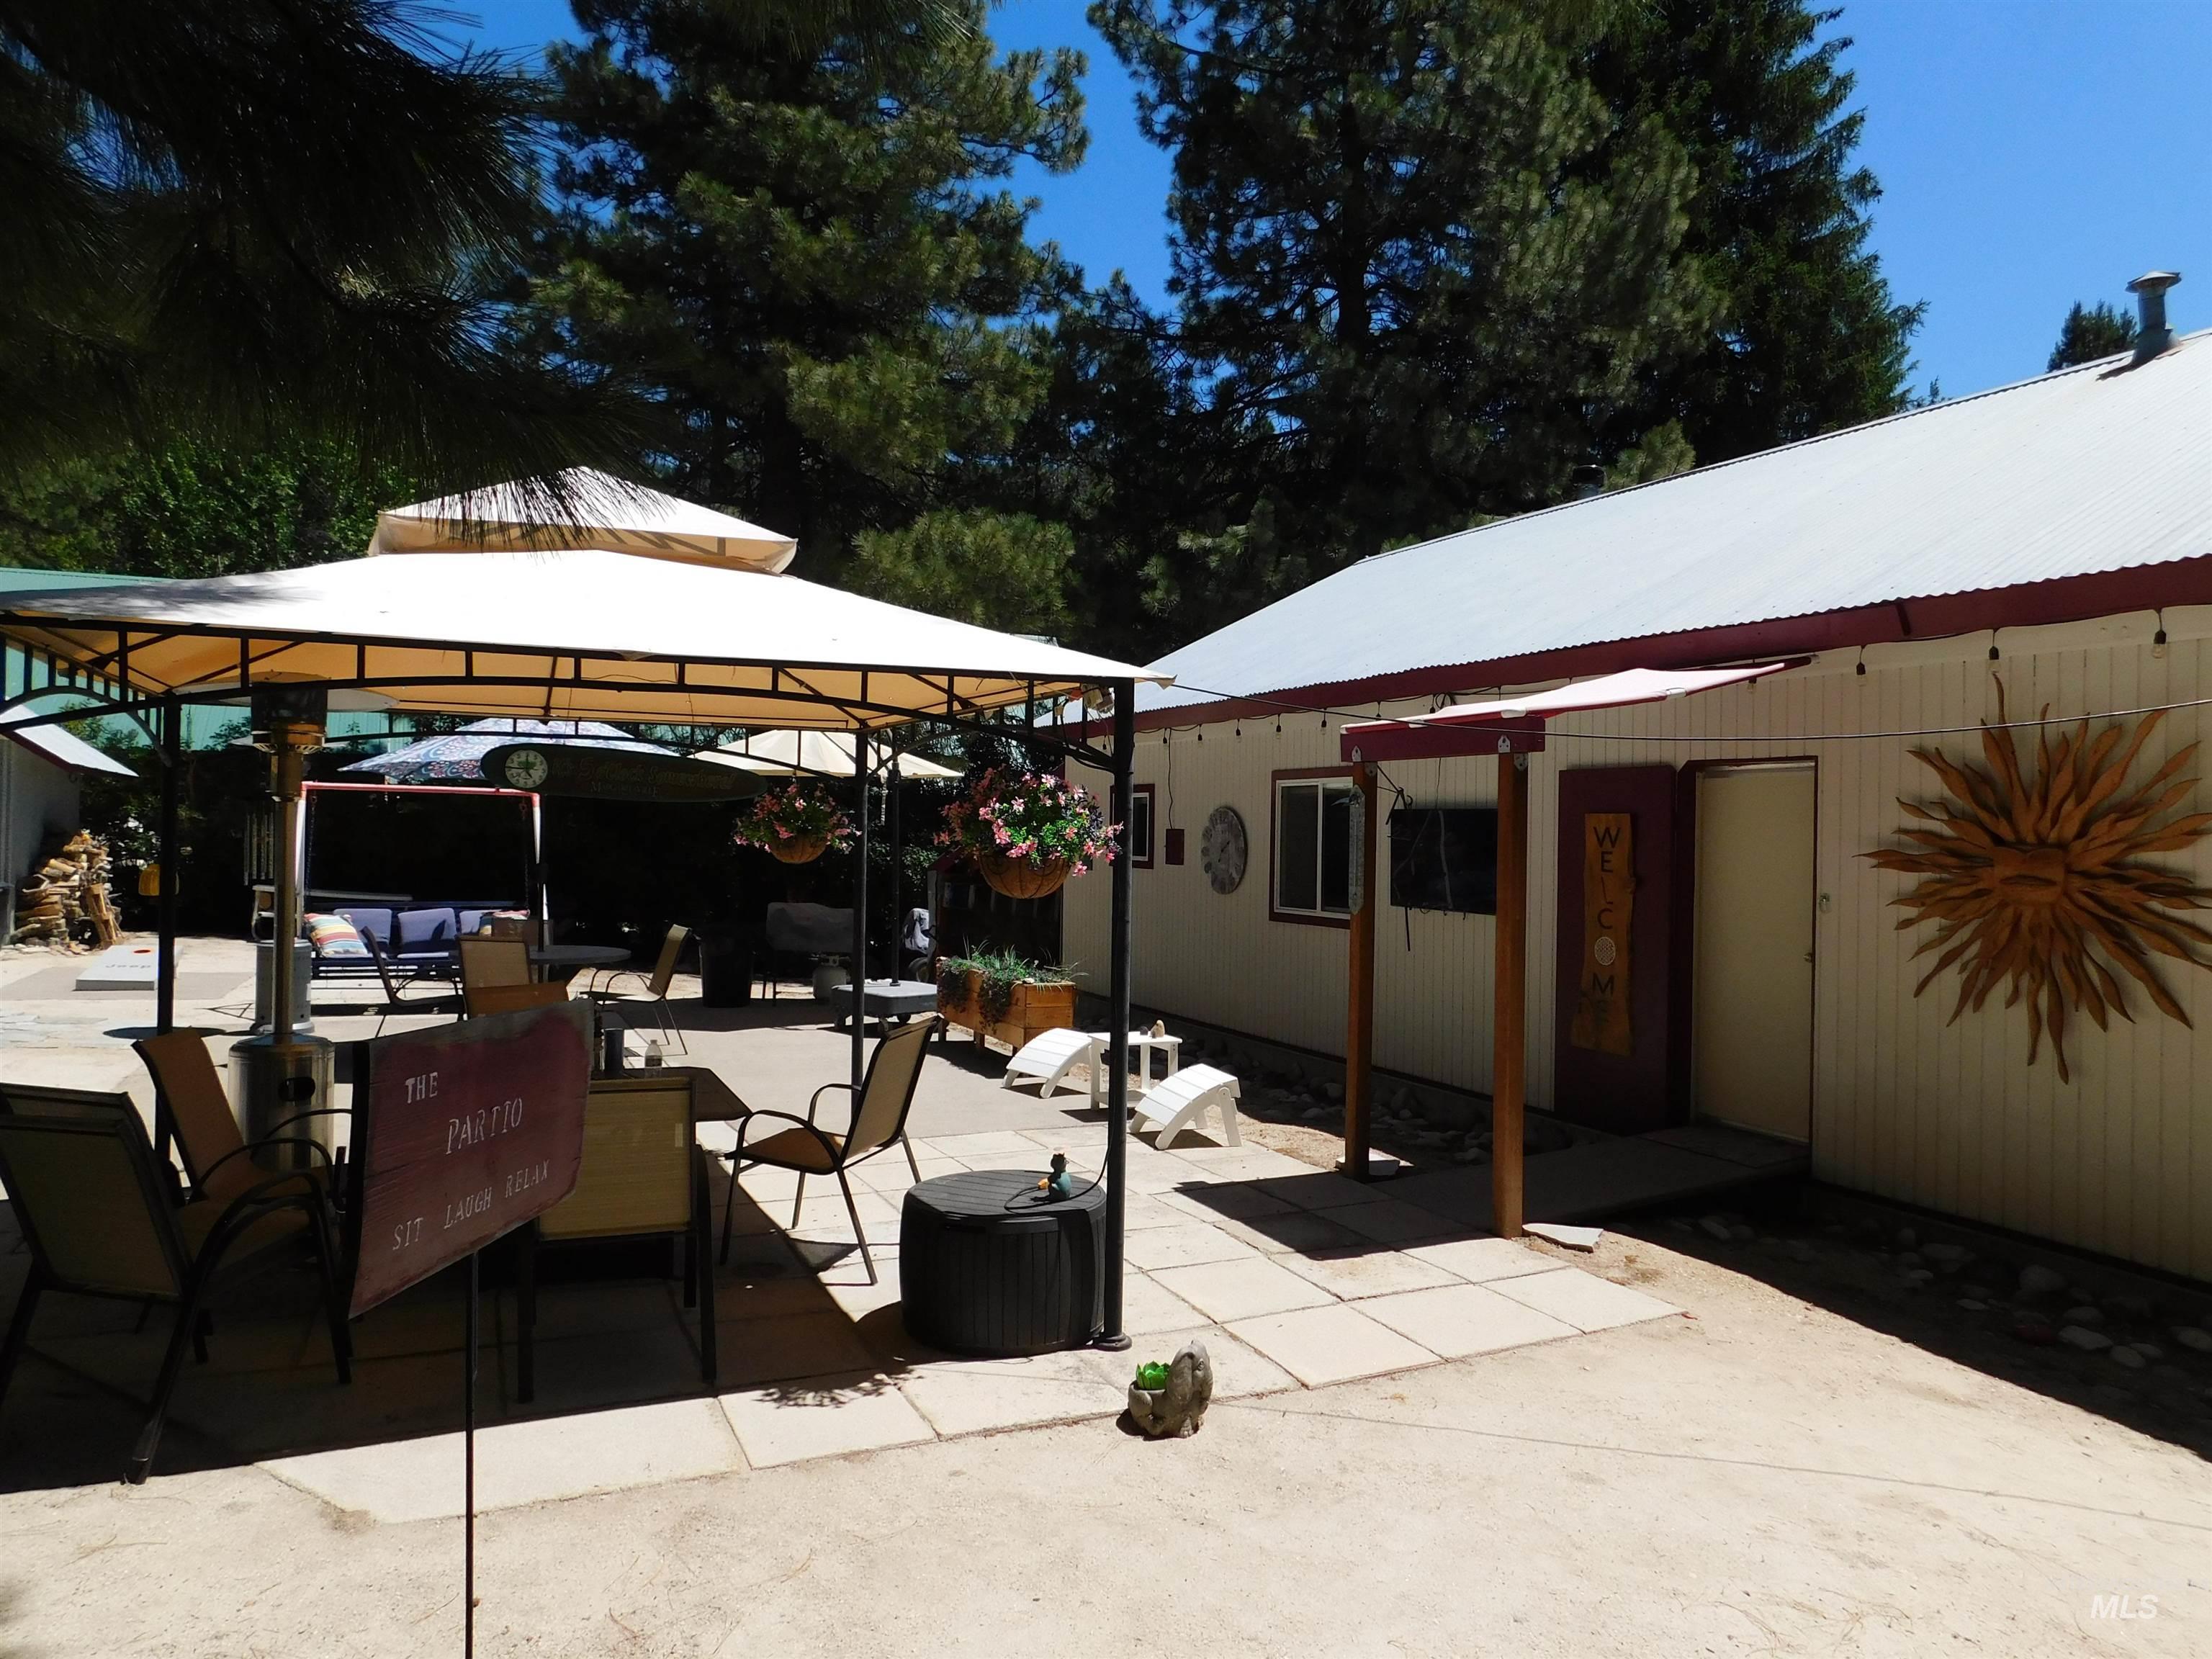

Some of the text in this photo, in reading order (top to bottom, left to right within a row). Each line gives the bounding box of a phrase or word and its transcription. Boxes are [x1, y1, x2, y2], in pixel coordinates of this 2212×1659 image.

[405, 1071, 439, 1104] THE
[445, 1097, 523, 1155] PARTIO
[392, 1159, 549, 1251] SIT LAUGH RELAX
